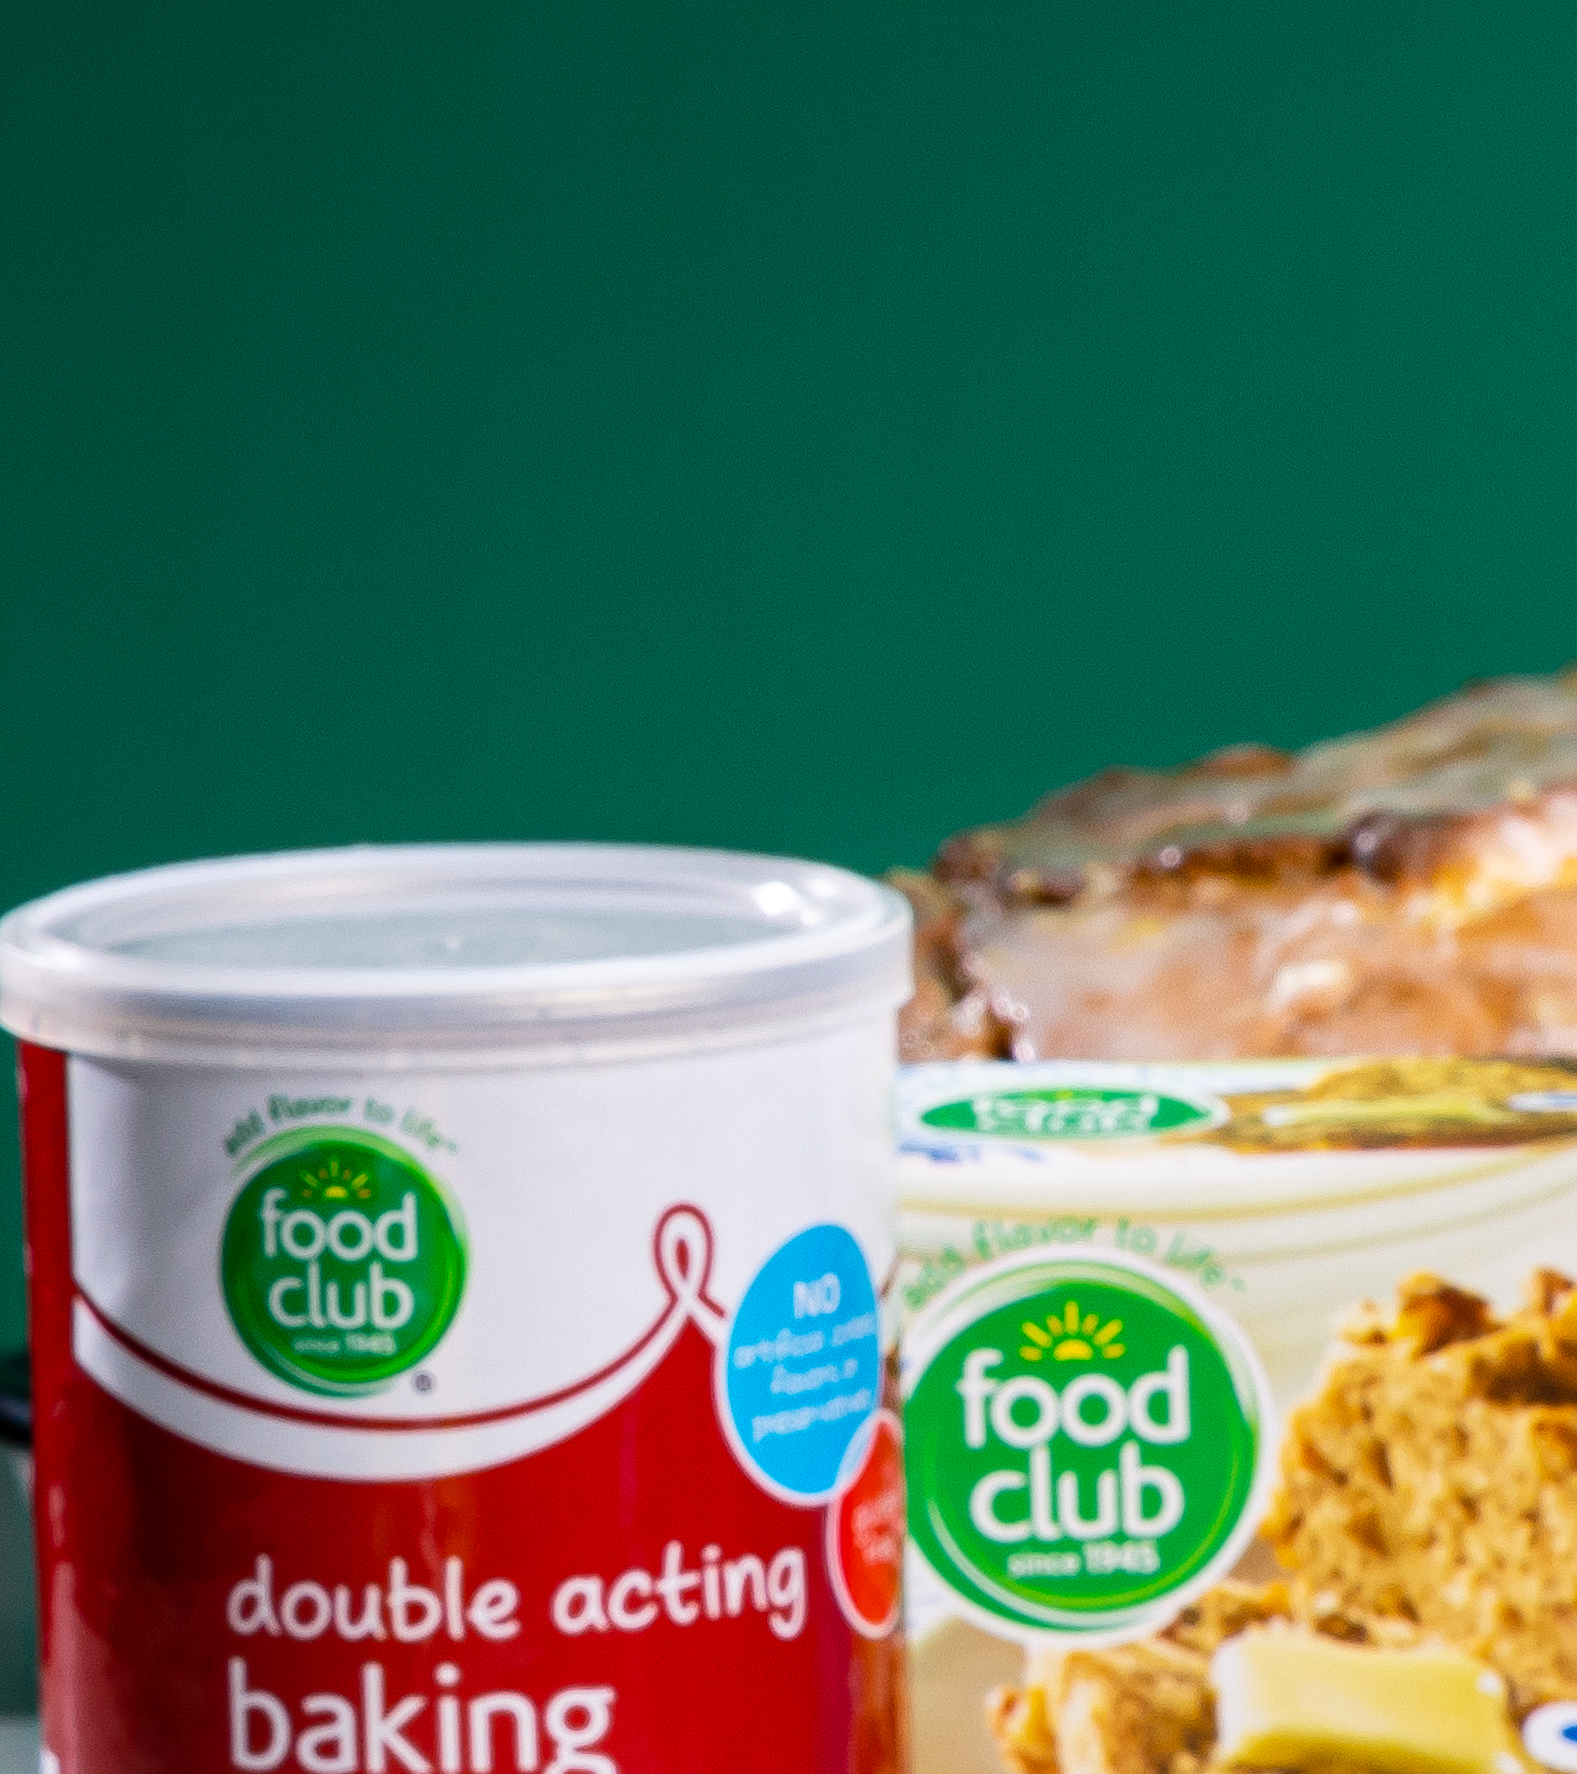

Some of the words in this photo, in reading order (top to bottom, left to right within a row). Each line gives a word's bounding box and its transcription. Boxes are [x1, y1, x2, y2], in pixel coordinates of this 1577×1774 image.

[260, 1186, 419, 1263] food
[267, 1260, 416, 1330] club
[792, 1272, 841, 1320] NO
[955, 1342, 1192, 1450] food
[968, 1439, 1186, 1544] club
[226, 1553, 522, 1641] double
[551, 1541, 807, 1641] acting
[1006, 1548, 1081, 1577] since
[1082, 1539, 1161, 1576] 1945
